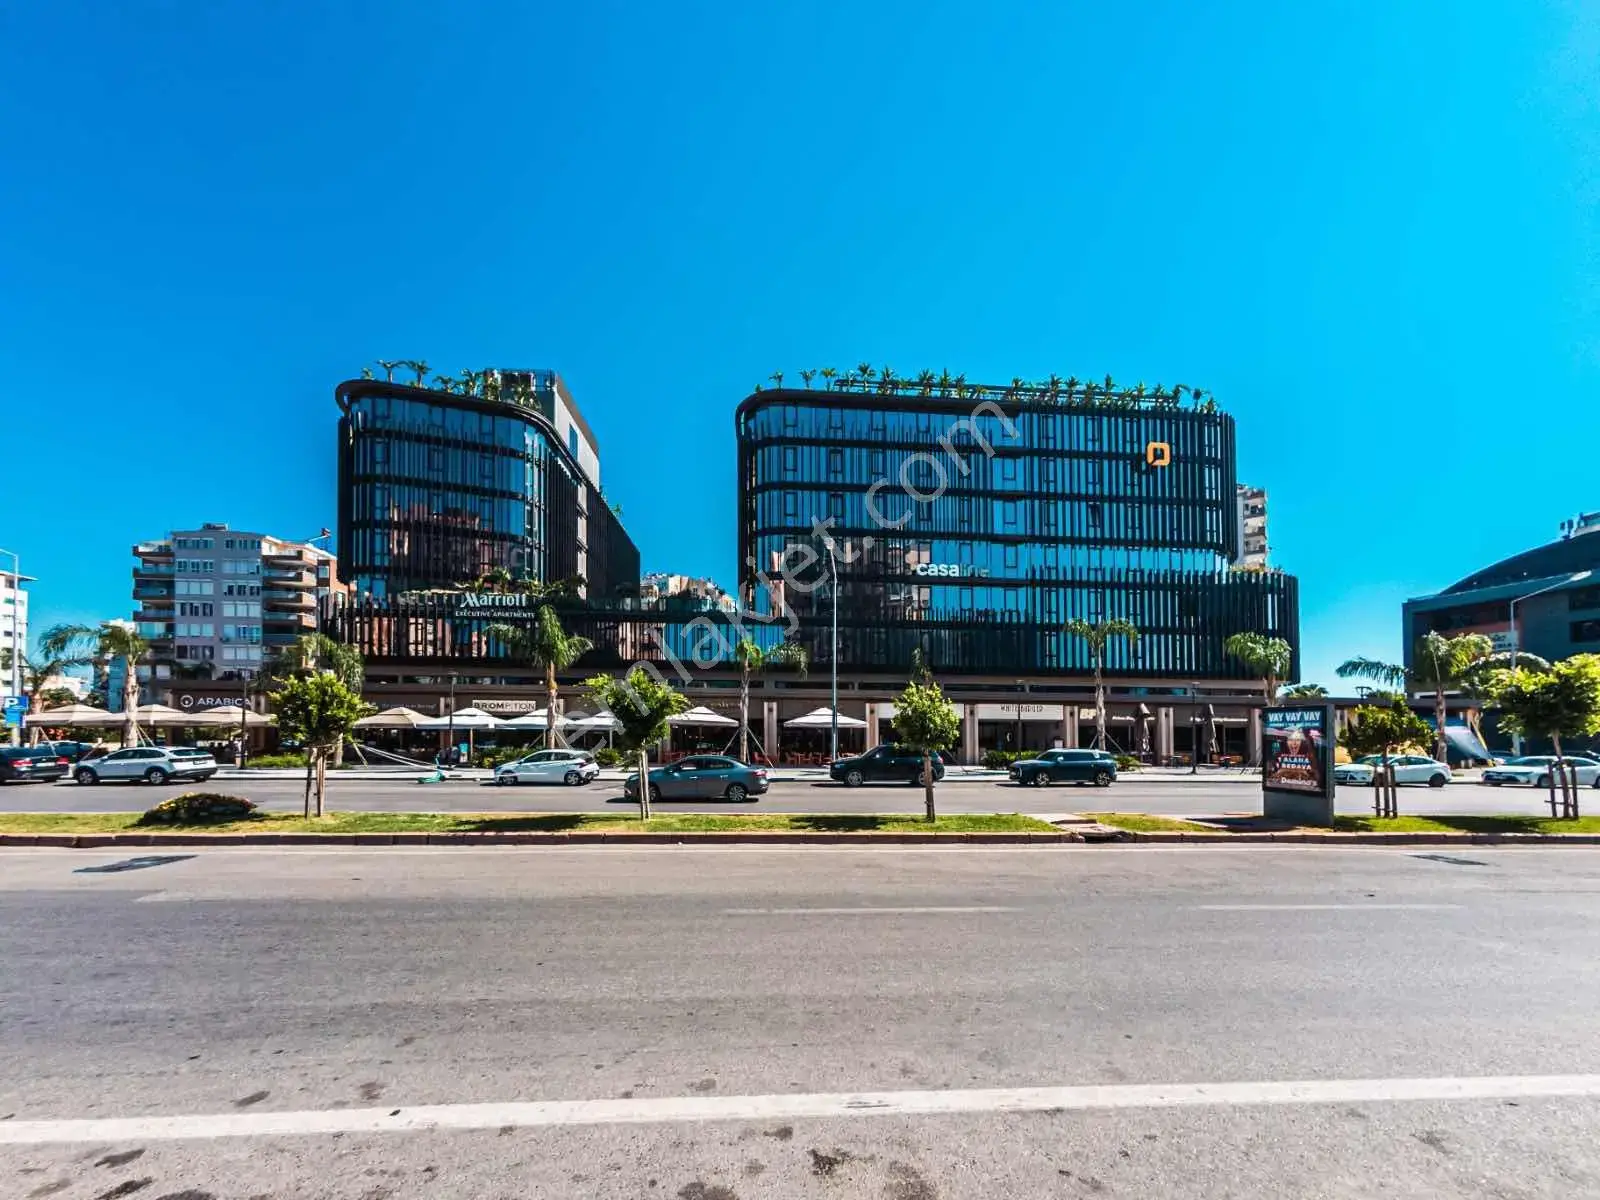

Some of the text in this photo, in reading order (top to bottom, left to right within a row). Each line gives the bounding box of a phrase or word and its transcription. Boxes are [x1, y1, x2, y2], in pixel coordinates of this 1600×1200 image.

[460, 591, 526, 607] Marriott
[197, 697, 252, 706] ARABICA
[1268, 711, 1321, 722] VAY VAY VAY
